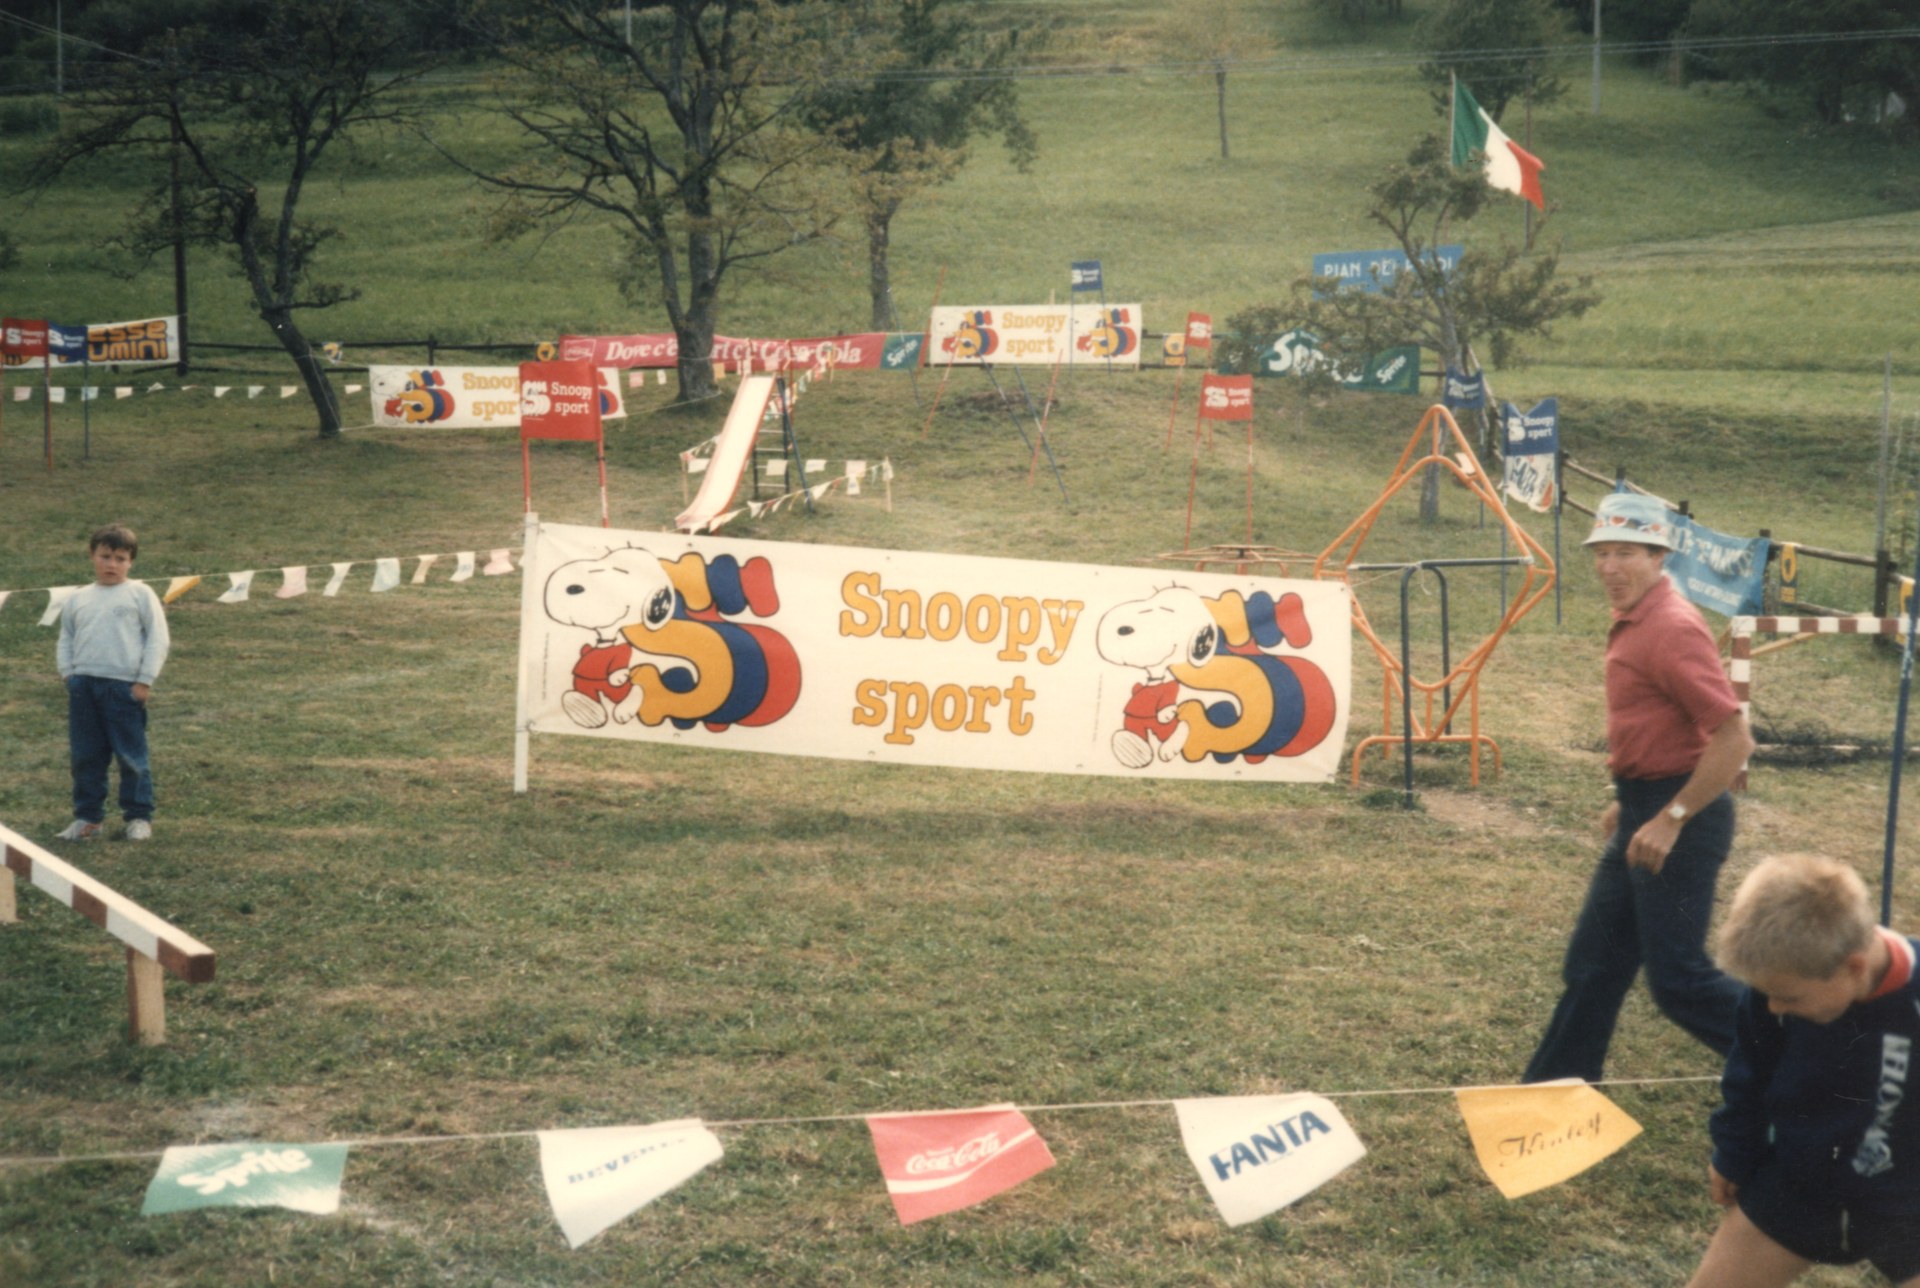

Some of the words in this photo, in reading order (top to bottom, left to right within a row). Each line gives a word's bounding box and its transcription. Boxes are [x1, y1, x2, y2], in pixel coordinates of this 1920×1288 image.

[1001, 311, 1067, 333] Snoopy
[1006, 335, 1055, 356] sport
[471, 399, 520, 421] spor
[554, 401, 590, 417] sport
[1527, 427, 1553, 441] sport
[838, 570, 1085, 666] Snoopy
[852, 675, 1036, 747] sport
[905, 1130, 1001, 1175] Coca-Cola
[1208, 1109, 1332, 1183] FANTA
[1497, 1111, 1601, 1168] Kinley
